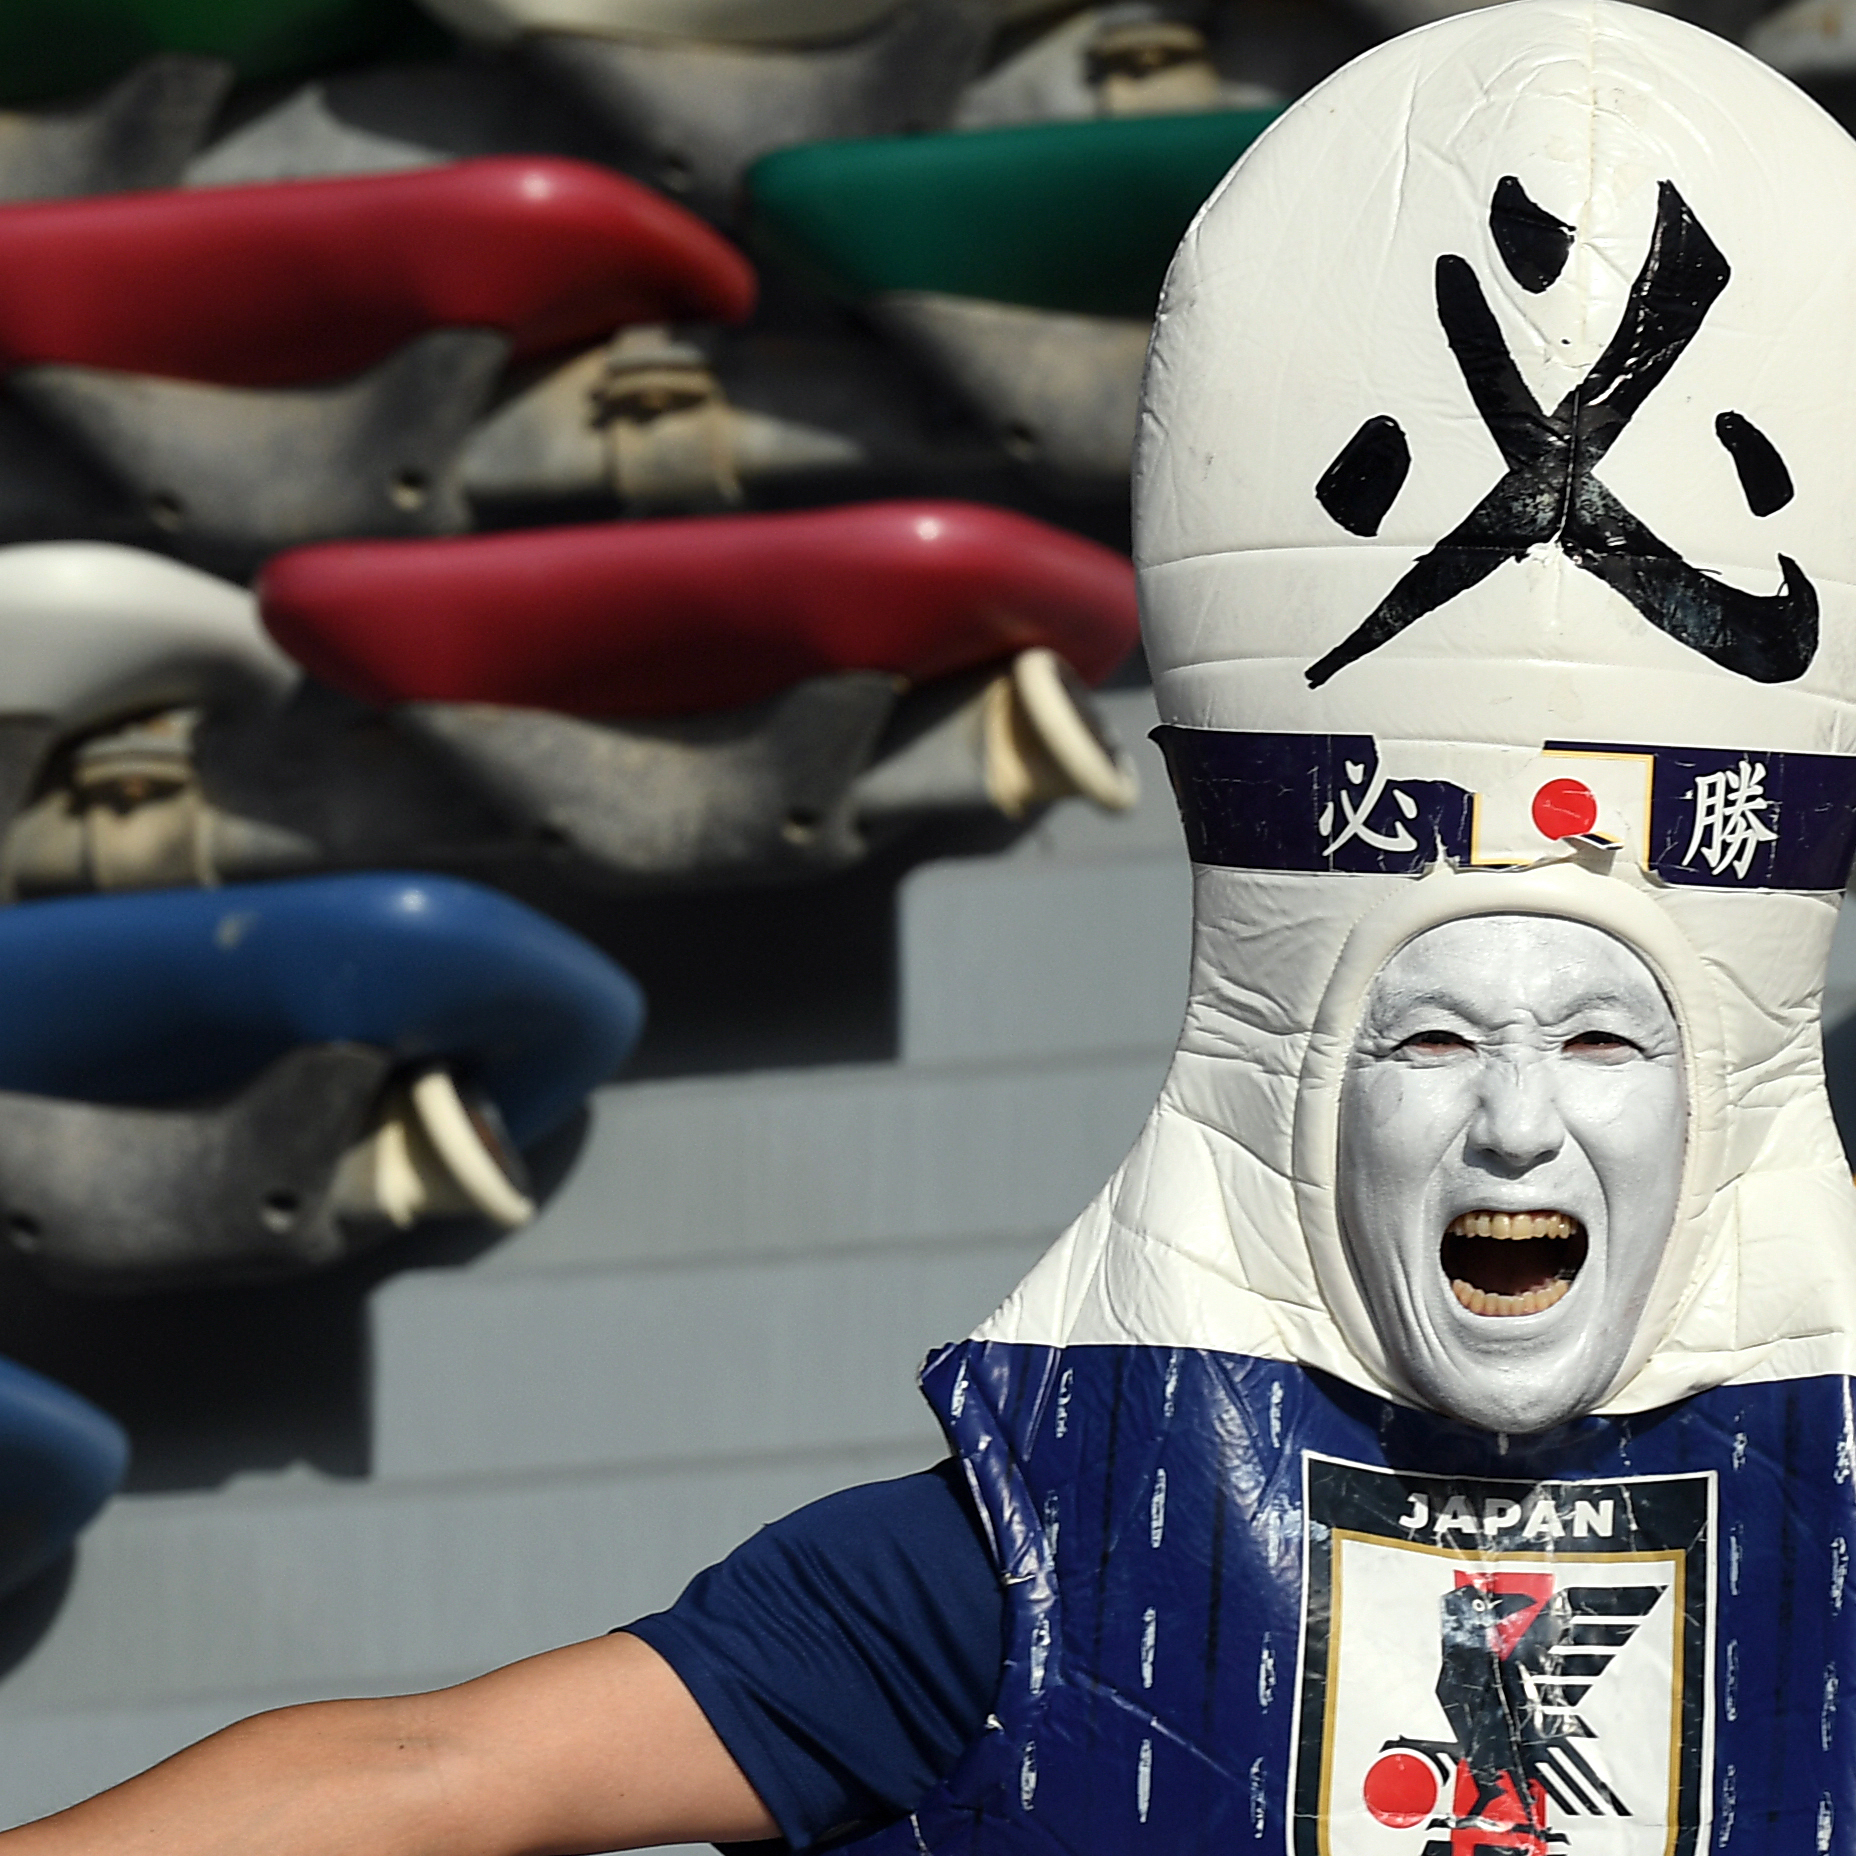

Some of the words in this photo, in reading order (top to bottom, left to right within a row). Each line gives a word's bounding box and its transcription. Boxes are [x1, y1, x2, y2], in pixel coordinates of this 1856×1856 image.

[1304, 174, 1819, 690] 必
[1318, 760, 1419, 860] 必
[1681, 761, 1780, 879] 勝
[1398, 1492, 1615, 1538] JAPAN
